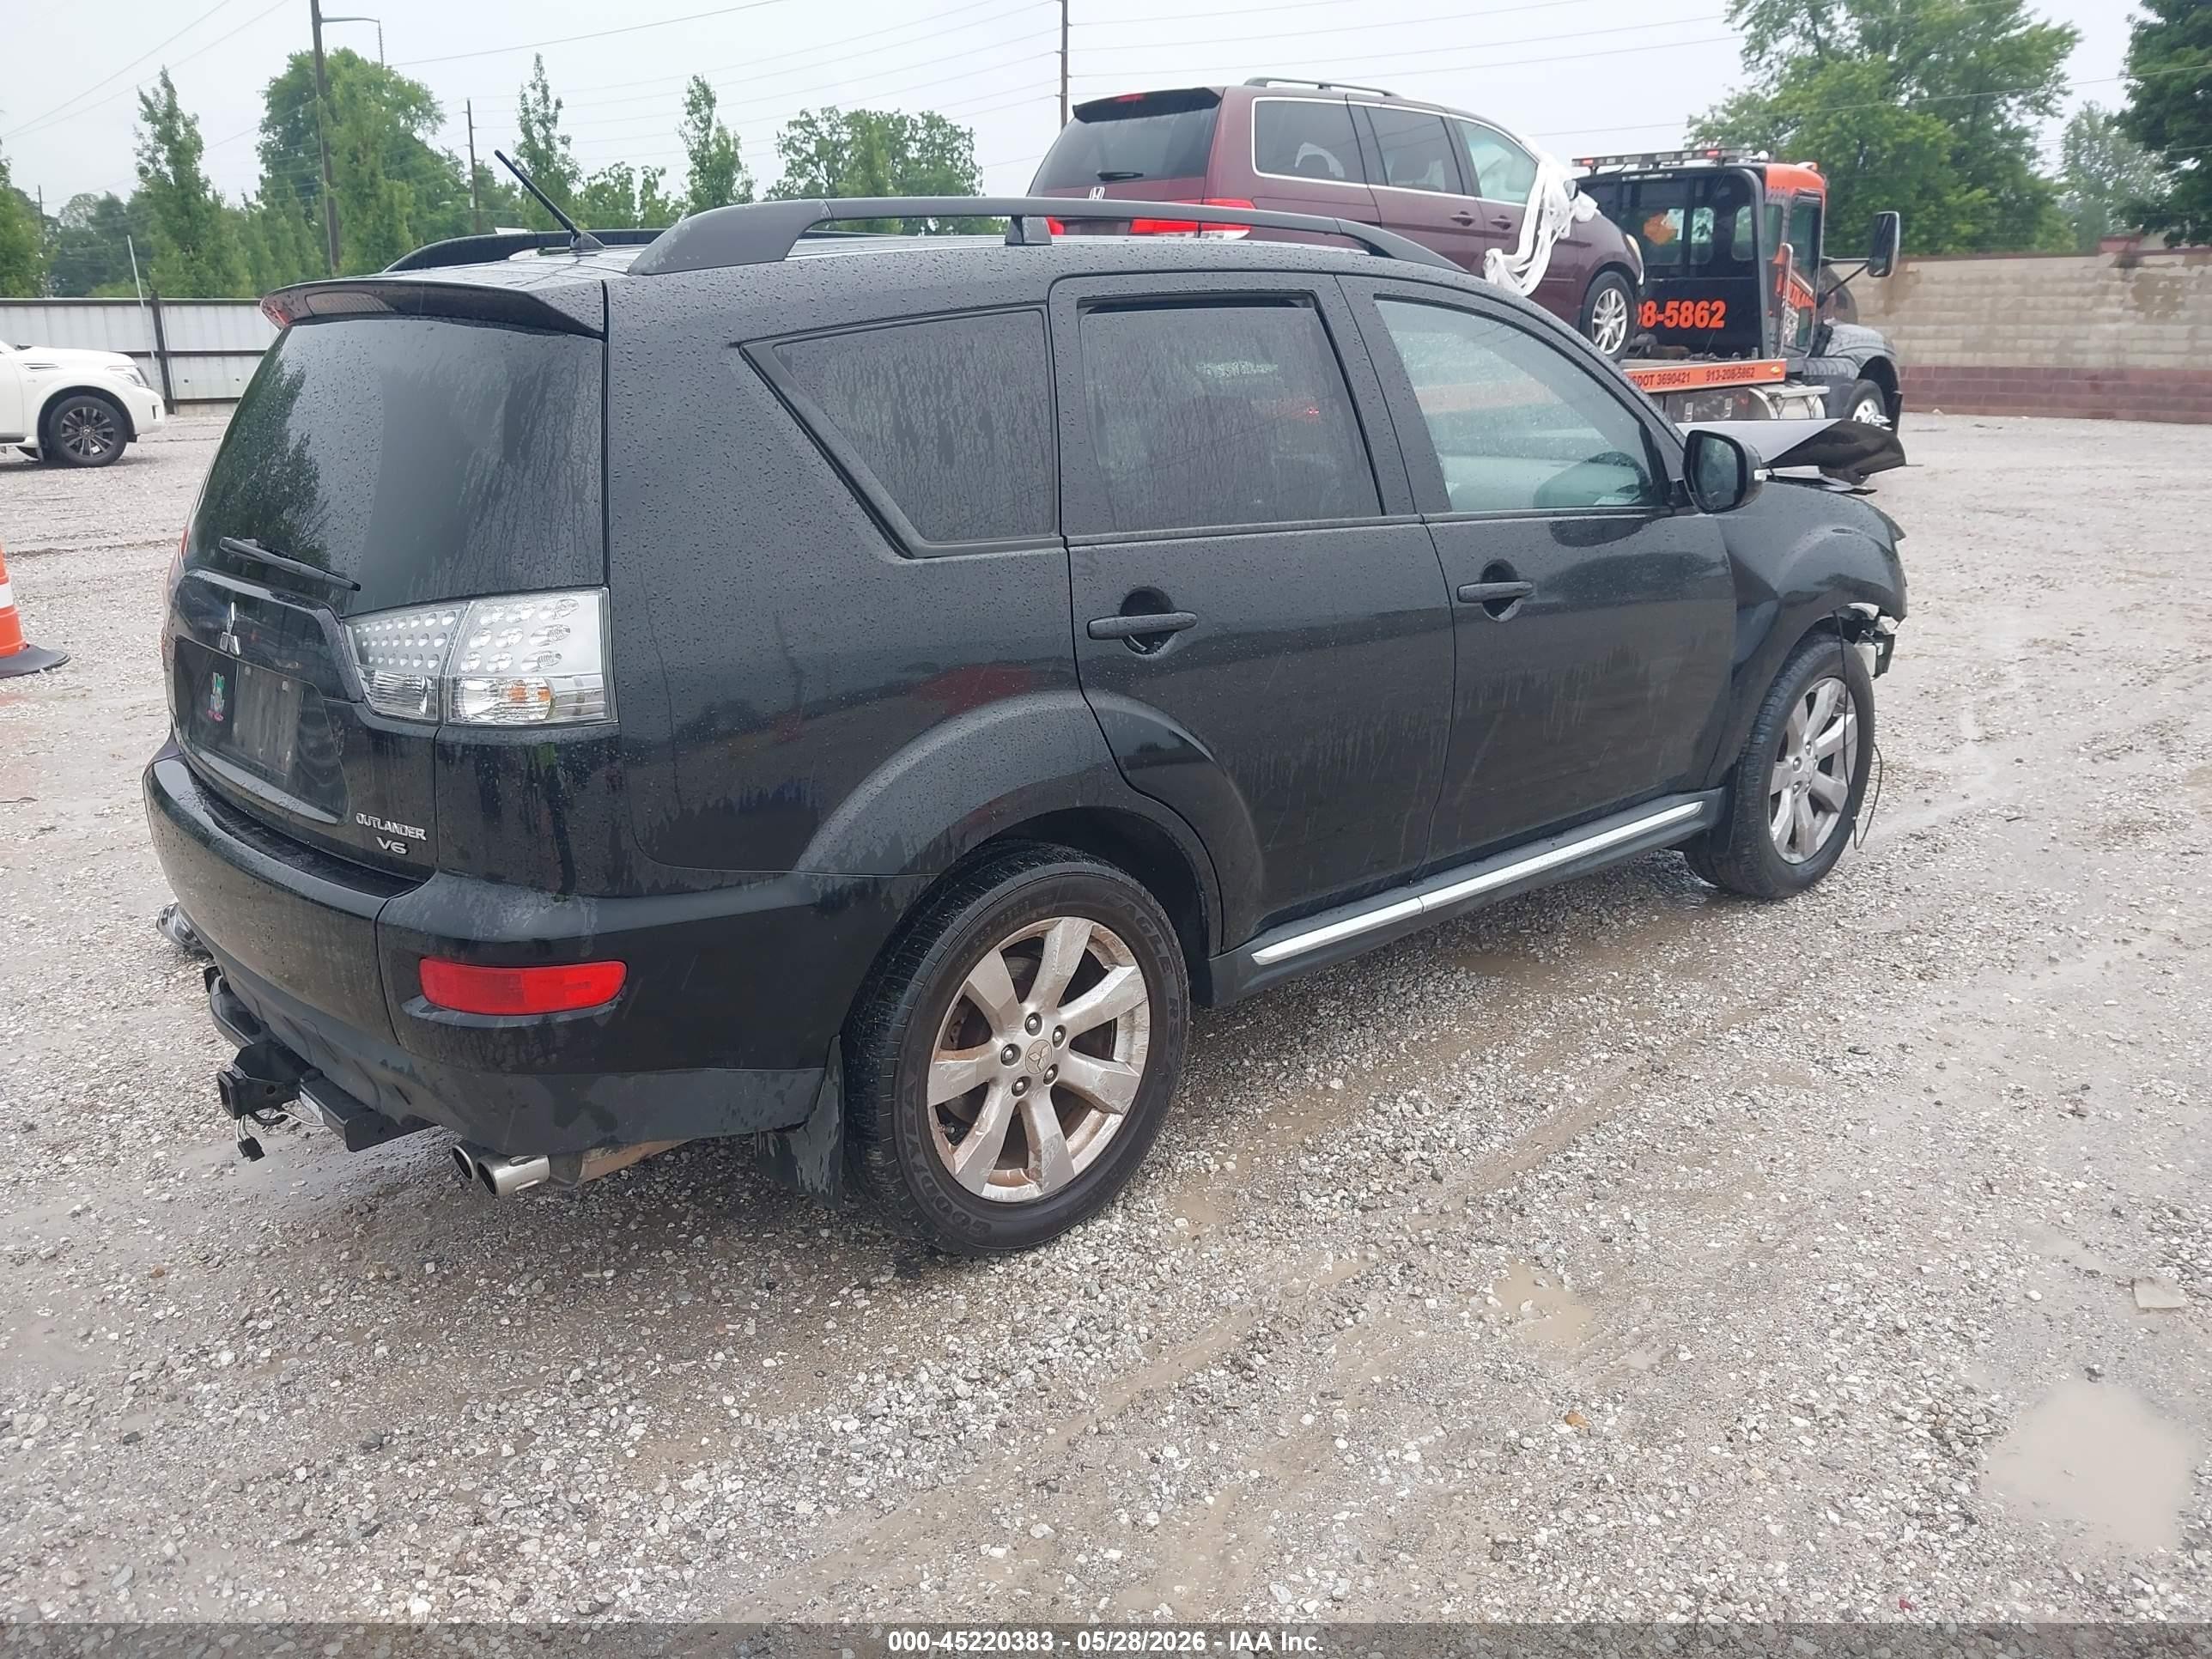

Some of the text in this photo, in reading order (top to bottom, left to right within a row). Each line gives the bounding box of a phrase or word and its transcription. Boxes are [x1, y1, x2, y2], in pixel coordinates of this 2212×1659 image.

[1638, 300, 1726, 329] 8-5862
[1656, 371, 1691, 386] 3690421
[356, 812, 427, 841] OUTLANDER
[376, 836, 407, 854] V6
